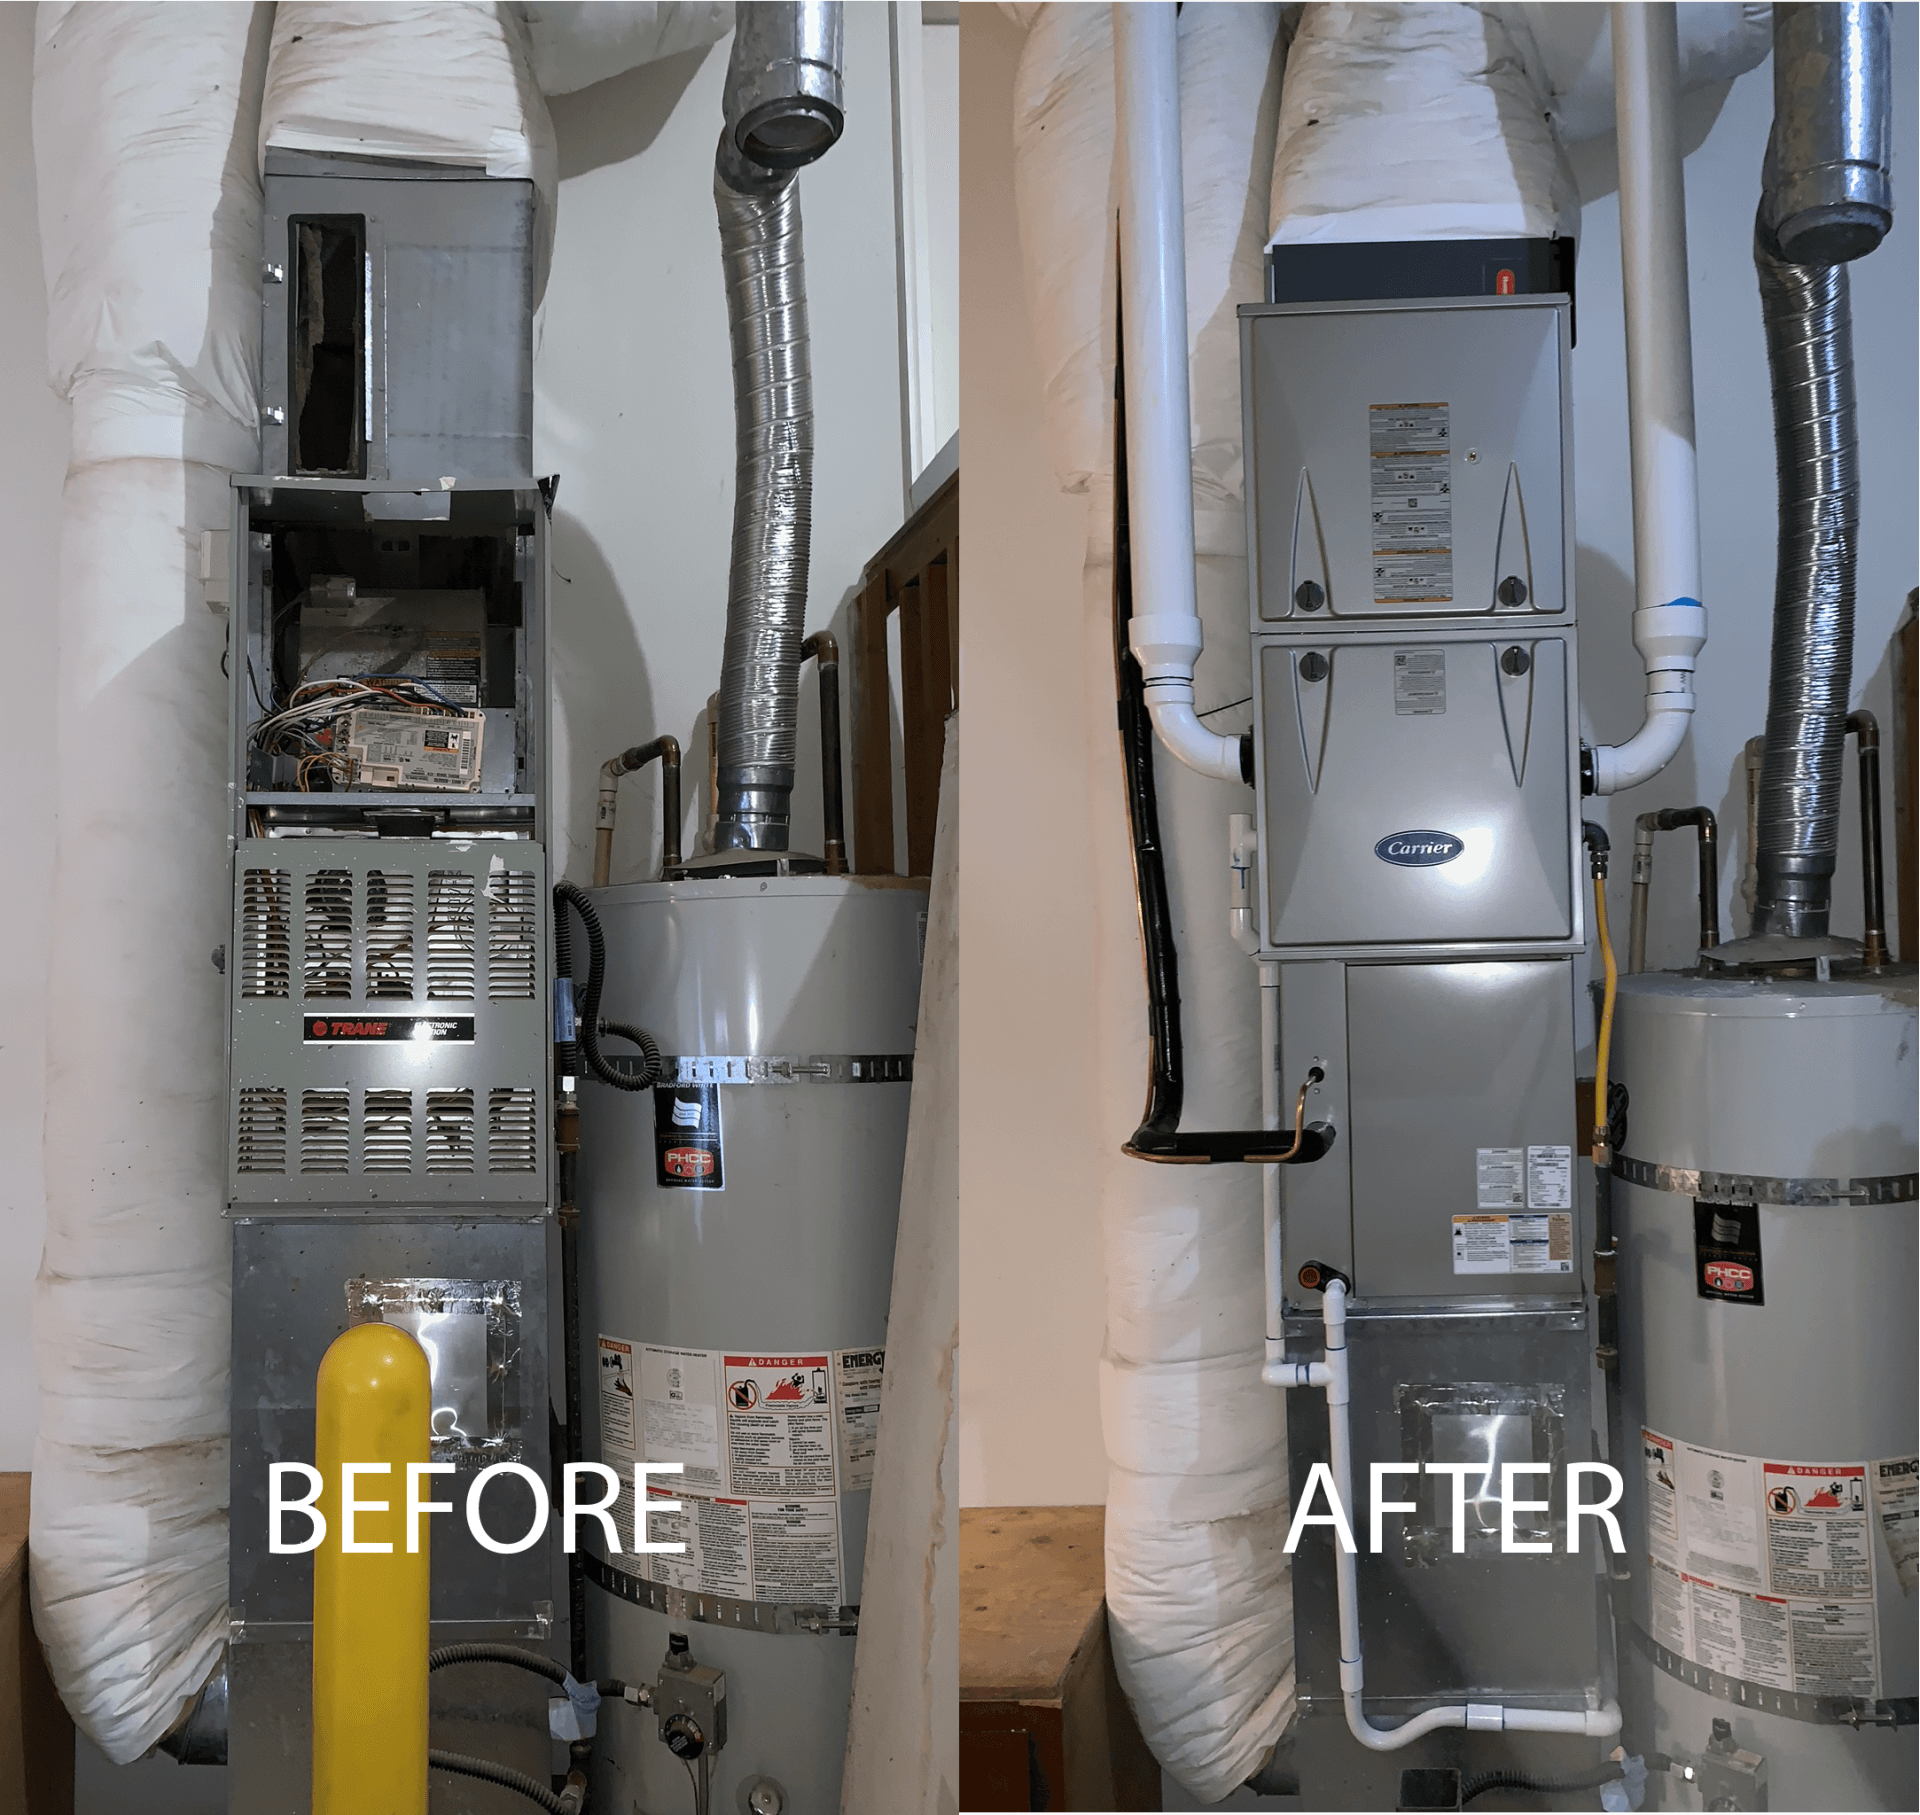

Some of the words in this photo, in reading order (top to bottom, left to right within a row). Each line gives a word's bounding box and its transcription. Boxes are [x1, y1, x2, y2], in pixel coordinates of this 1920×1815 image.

[1387, 841, 1453, 855] Carrier
[331, 1022, 388, 1036] TRANE
[656, 1081, 690, 1089] BRADFORD
[667, 1152, 711, 1164] PHCC
[1707, 1266, 1751, 1279] PHCC
[606, 1341, 630, 1352] DANGER
[1796, 1467, 1842, 1475] DANGER
